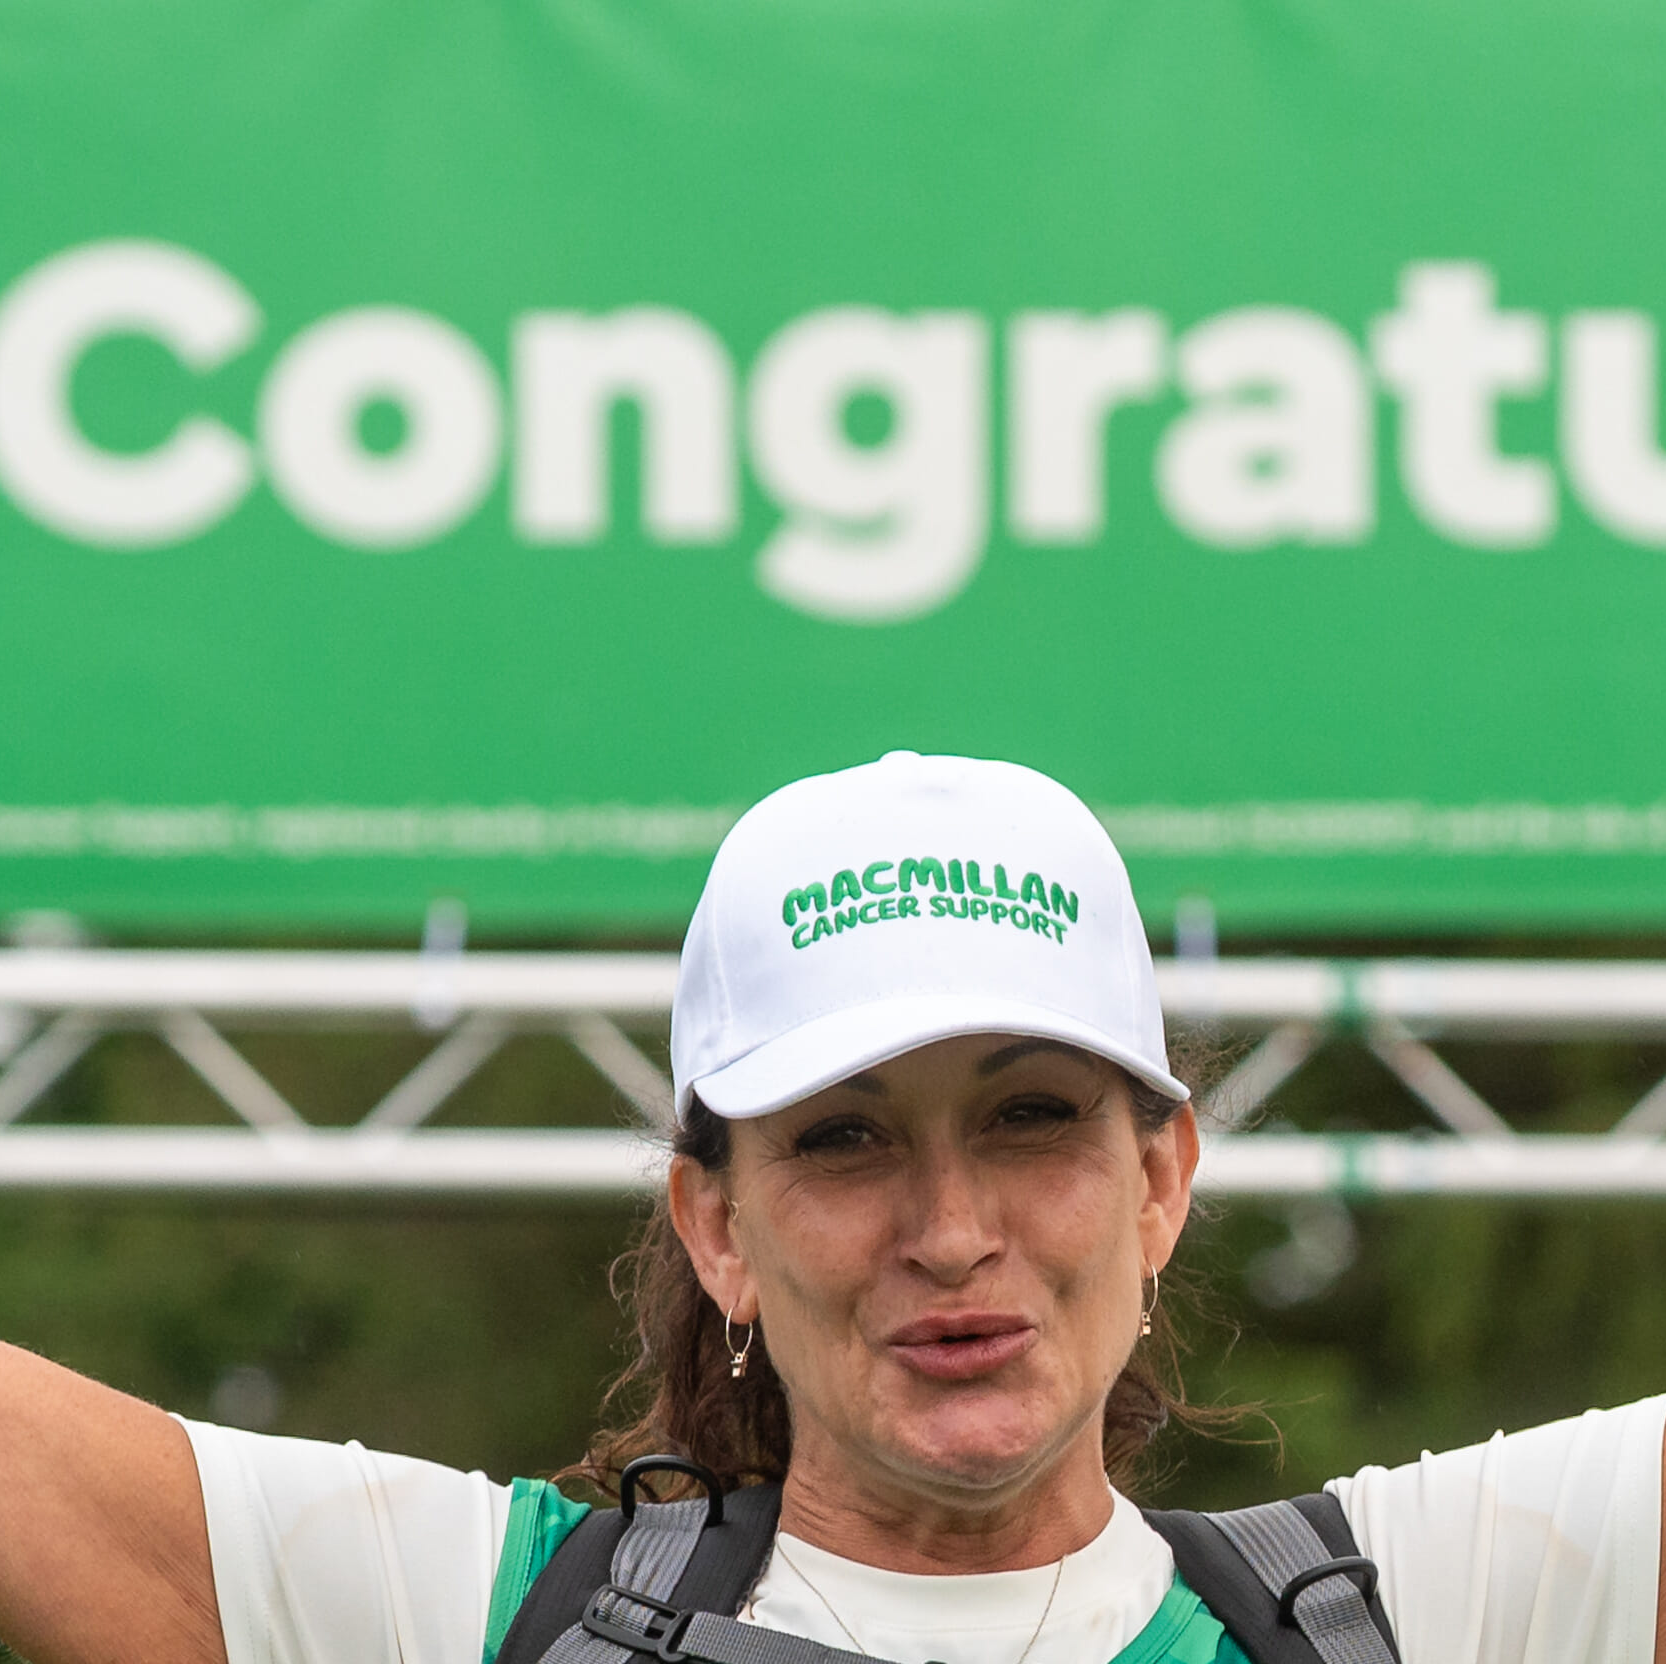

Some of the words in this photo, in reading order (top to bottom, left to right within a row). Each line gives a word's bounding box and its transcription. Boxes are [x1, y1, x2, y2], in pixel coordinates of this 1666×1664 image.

[782, 856, 1079, 927] MACMILLAN
[791, 895, 921, 950] CANCER
[929, 894, 1069, 945] SUPPORT
